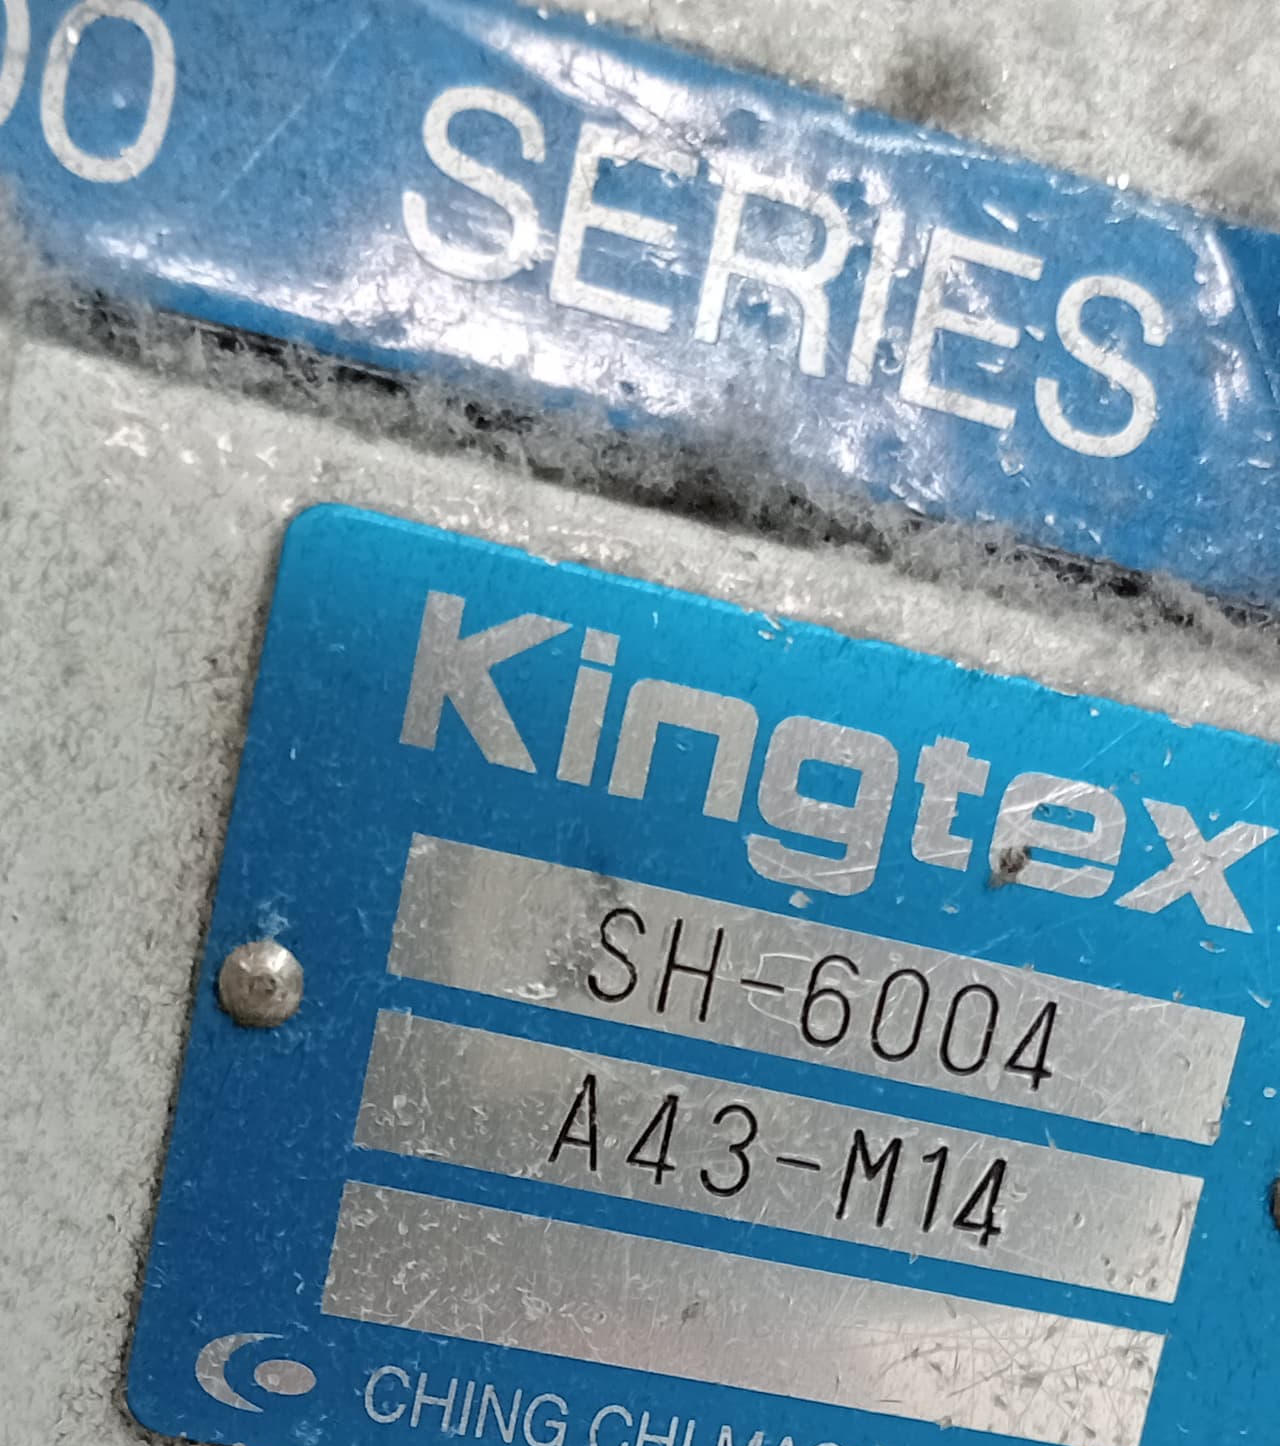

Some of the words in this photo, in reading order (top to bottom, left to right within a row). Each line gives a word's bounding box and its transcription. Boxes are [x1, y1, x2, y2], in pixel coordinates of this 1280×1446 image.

[402, 86, 1170, 458] SERIES
[398, 588, 1280, 935] Kingtex
[586, 907, 1058, 1091] SH-6004
[547, 1073, 1008, 1247] A43-M14
